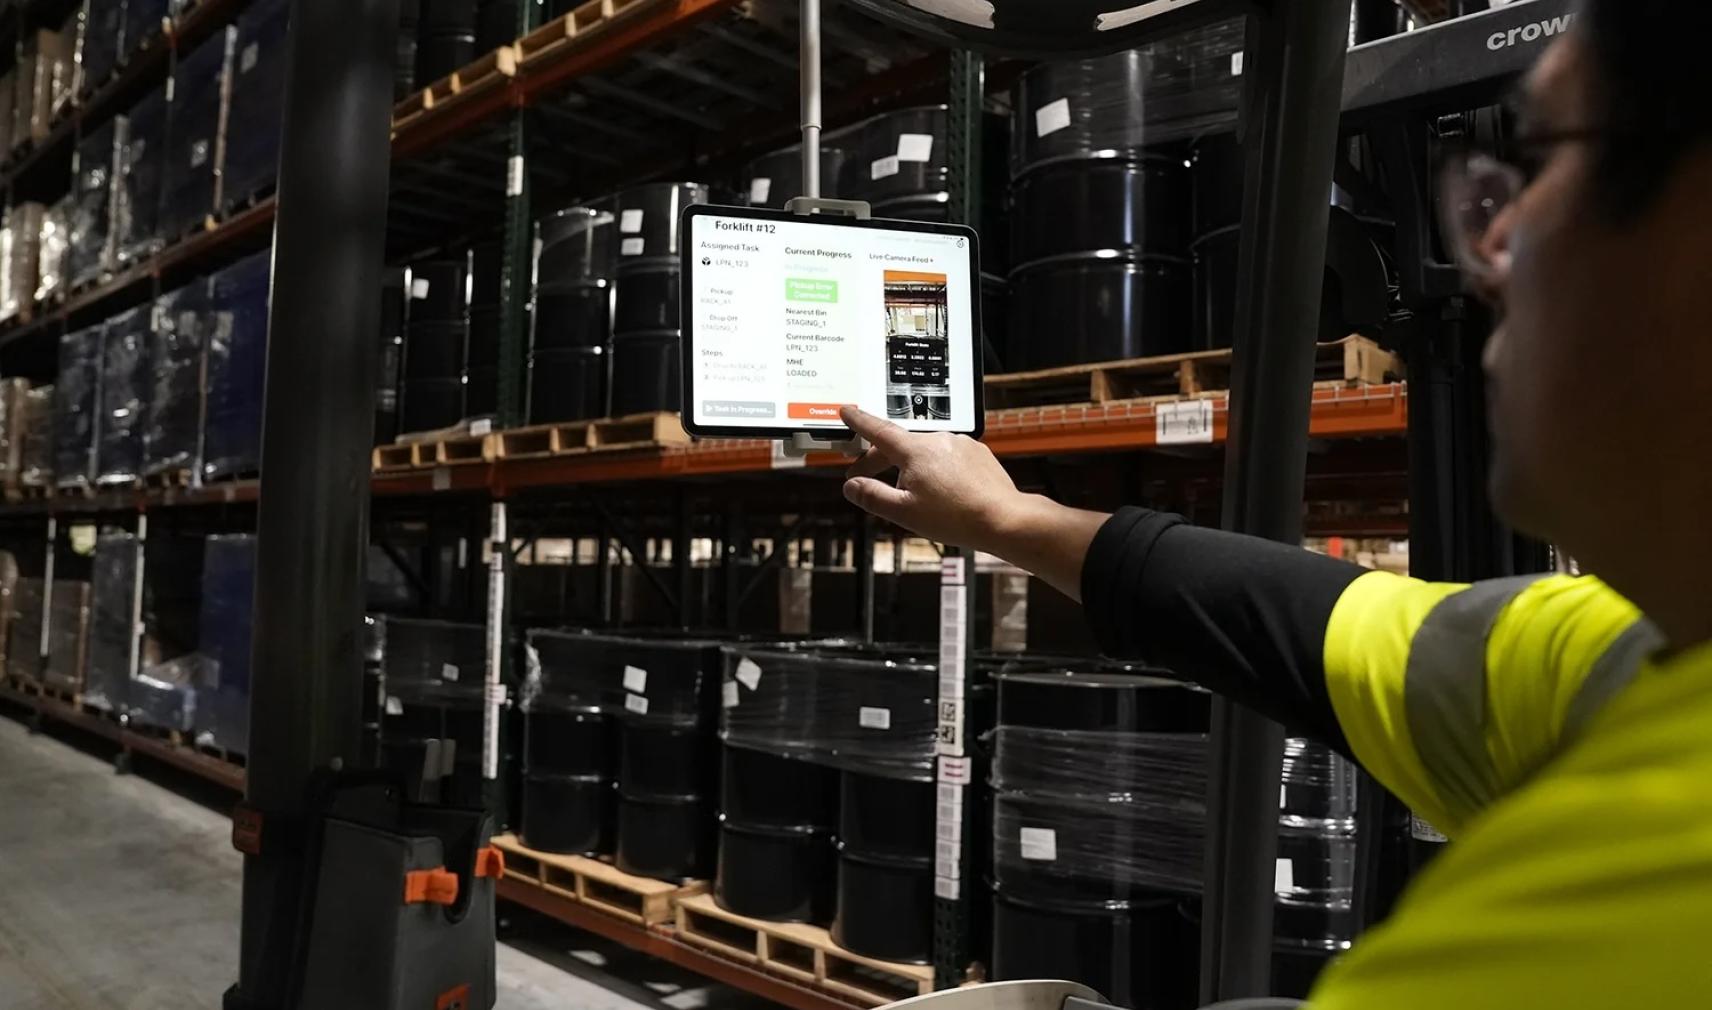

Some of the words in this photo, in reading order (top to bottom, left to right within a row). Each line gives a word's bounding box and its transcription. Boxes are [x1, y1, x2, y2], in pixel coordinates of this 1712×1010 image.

[1486, 12, 1577, 51] crow
[715, 220, 753, 232] Forklift
[756, 224, 776, 234] #12
[701, 241, 740, 251] Assigned
[741, 244, 759, 252] Task
[785, 246, 816, 256] Current
[817, 249, 852, 259] Progress
[884, 253, 911, 263] Camera
[912, 255, 929, 264] Feed
[785, 307, 814, 316] Nearest
[815, 309, 827, 317] Bin
[785, 333, 814, 341] Current
[701, 349, 724, 358] Steps
[786, 358, 804, 366] MHE
[786, 369, 818, 378] LOADED
[809, 407, 838, 416] Override
